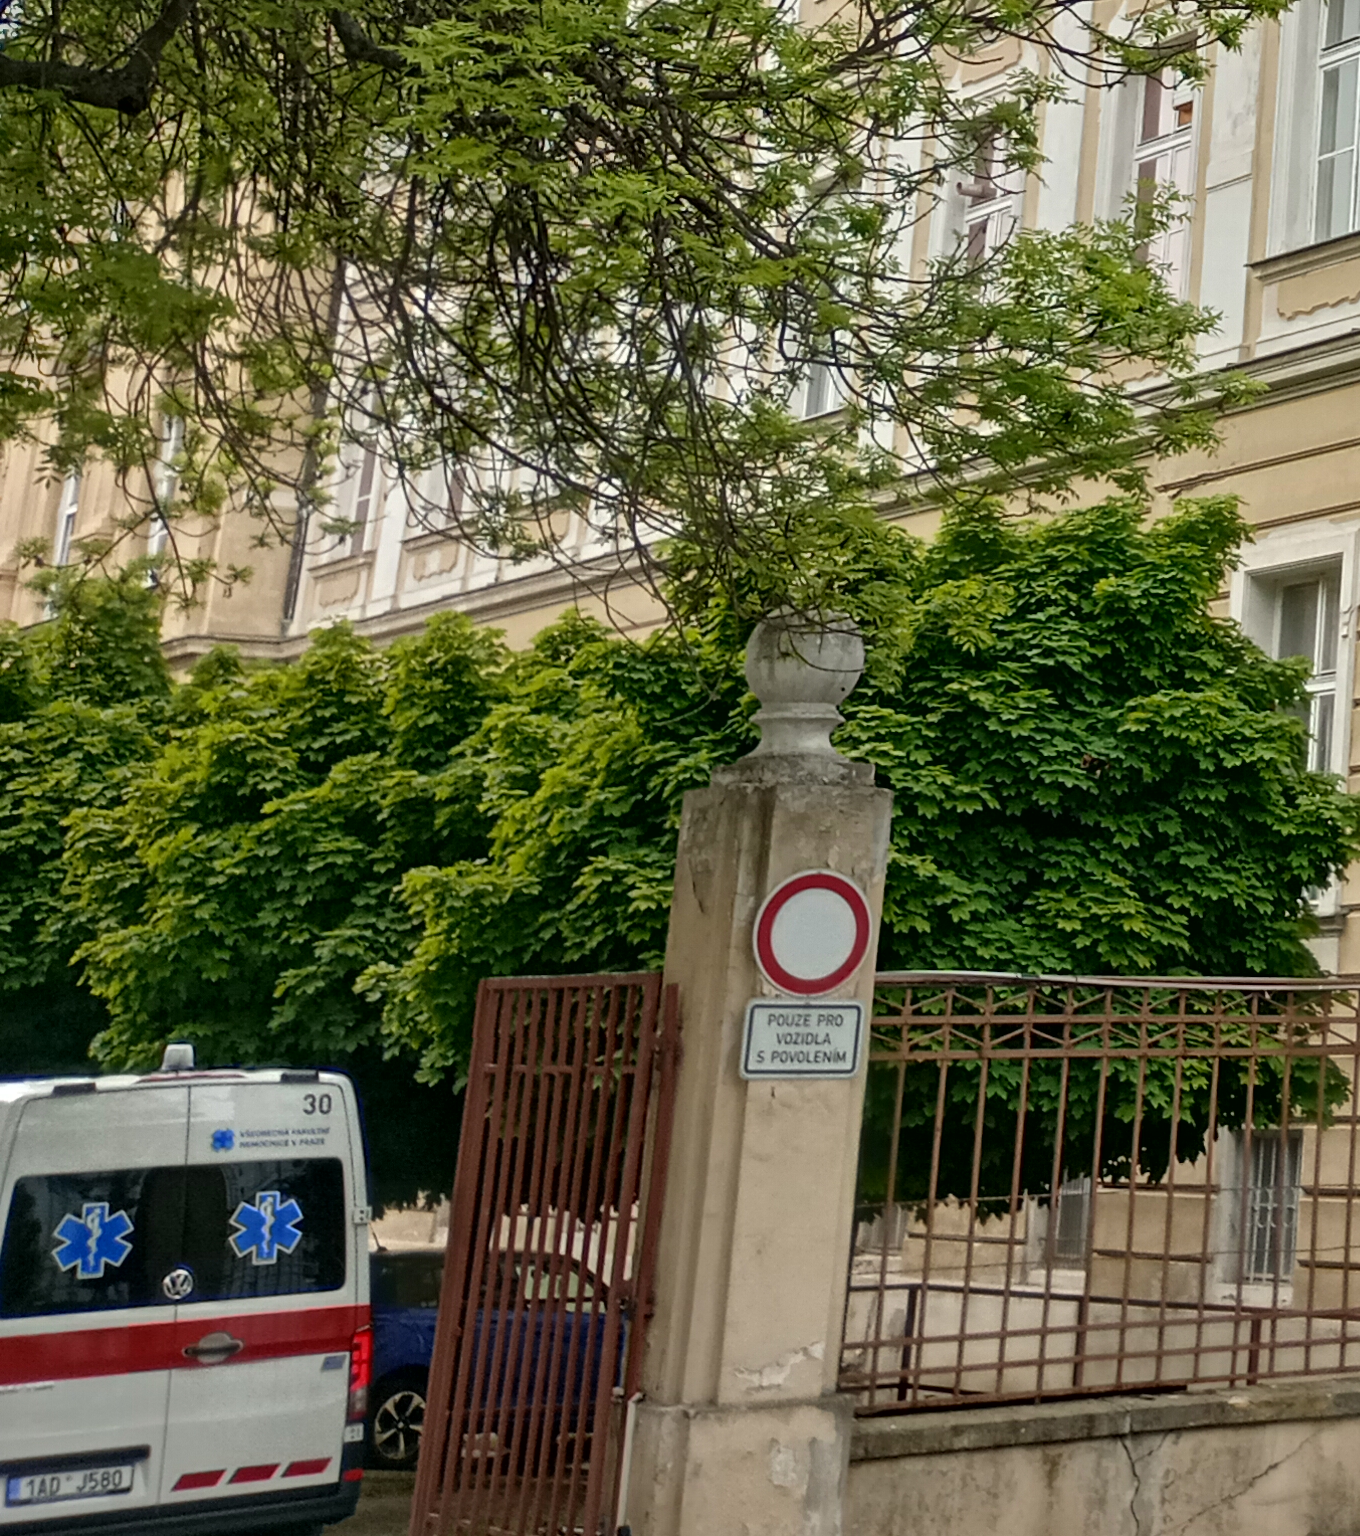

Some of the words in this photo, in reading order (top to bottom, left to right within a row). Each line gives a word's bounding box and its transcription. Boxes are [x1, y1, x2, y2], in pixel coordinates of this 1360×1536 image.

[767, 1013, 812, 1028] POUZE
[816, 1013, 844, 1028] PRO
[776, 1032, 831, 1046] VOZIDLA
[756, 1050, 765, 1064] S
[770, 1047, 847, 1064] POVOLENÍM
[302, 1093, 332, 1115] 30
[26, 1476, 60, 1498] 1AD
[76, 1469, 123, 1493] J580
